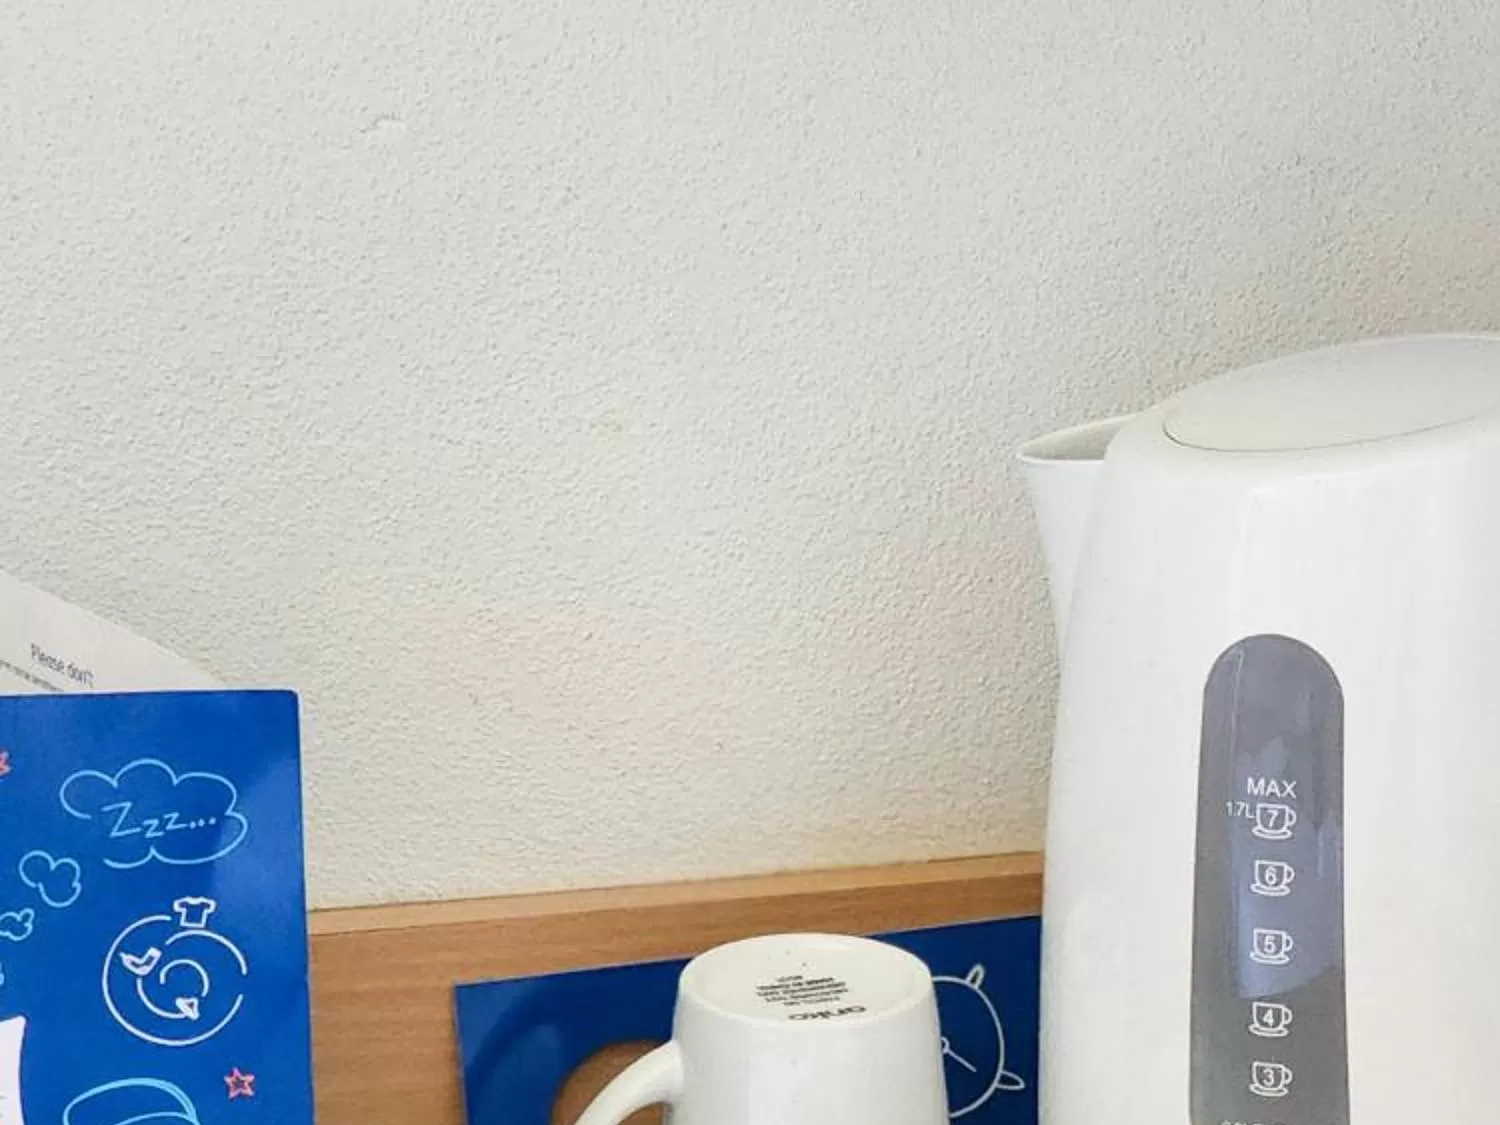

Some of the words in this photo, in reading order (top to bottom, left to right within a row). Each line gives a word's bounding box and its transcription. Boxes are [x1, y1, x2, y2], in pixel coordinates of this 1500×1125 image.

[1246, 776, 1297, 799] MAX
[1267, 809, 1279, 828] 7
[1265, 868, 1277, 885] 6
[1263, 936, 1275, 954] 5
[1263, 1009, 1275, 1027] 4
[1263, 1068, 1275, 1086] 3
